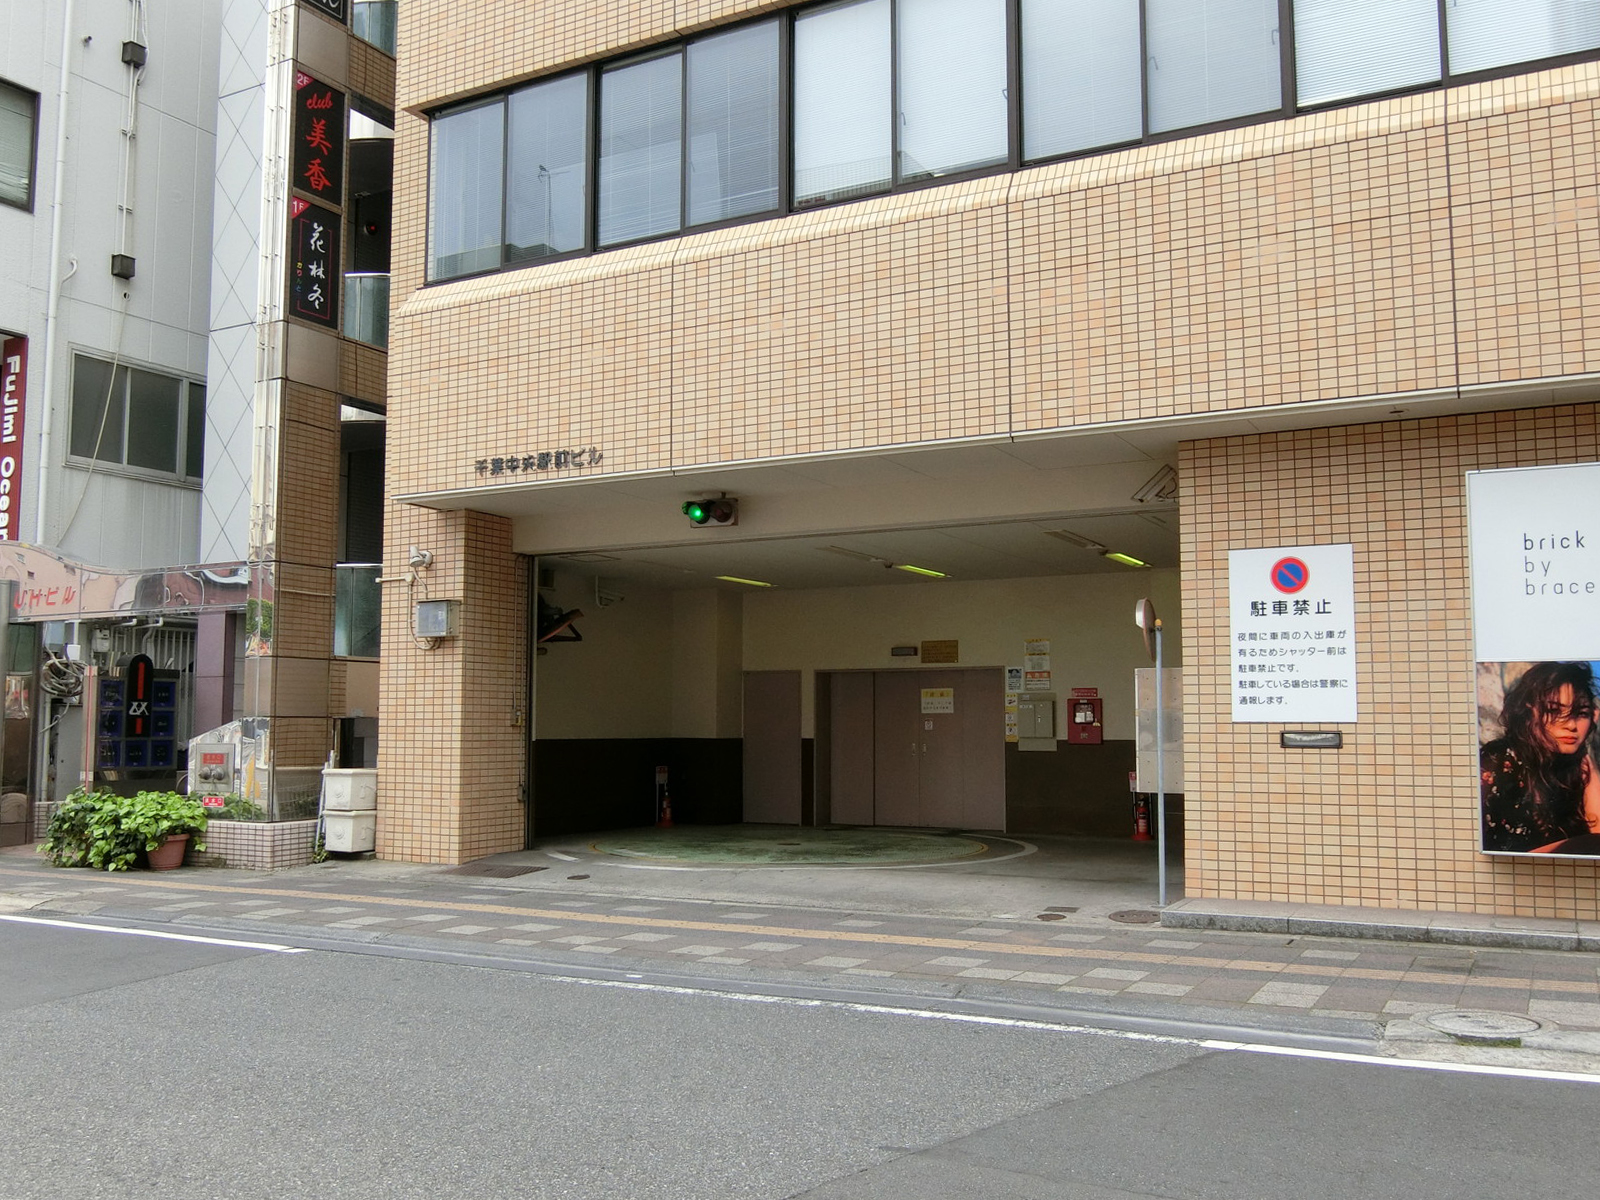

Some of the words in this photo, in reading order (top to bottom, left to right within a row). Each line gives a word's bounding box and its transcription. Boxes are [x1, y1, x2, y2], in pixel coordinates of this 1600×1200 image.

[298, 74, 310, 85] 2F
[306, 91, 333, 109] club
[304, 117, 332, 191] 美香
[292, 201, 304, 213] 1F
[2, 354, 21, 443] Fujimi
[474, 446, 603, 477] 千葉中央駅前ビル
[1523, 530, 1585, 551] brick
[1524, 555, 1551, 577] by
[1525, 578, 1596, 595] brace
[1250, 598, 1332, 617] 駐車禁止
[1237, 630, 1347, 642] 夜間に車両の入出庫が
[1238, 646, 1347, 657] 有るためシャッター前は
[1238, 679, 1348, 689] 駐車している場合は警察に
